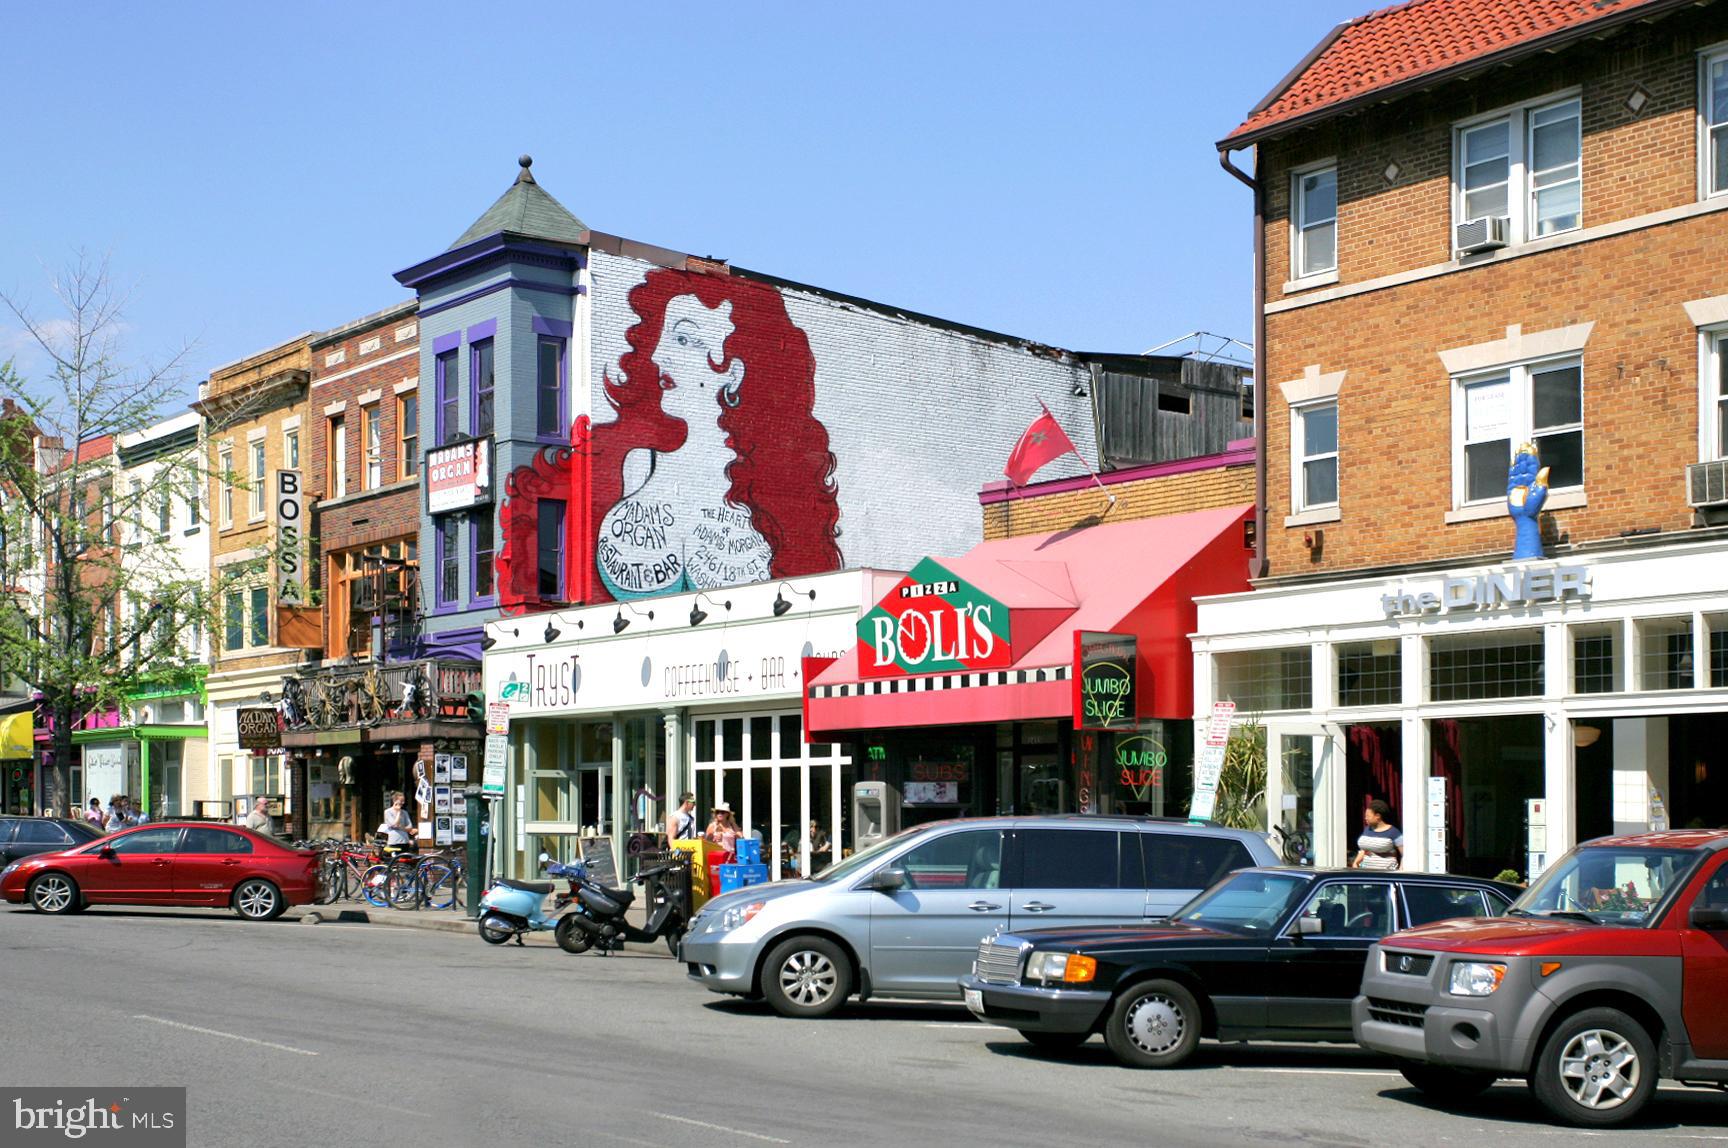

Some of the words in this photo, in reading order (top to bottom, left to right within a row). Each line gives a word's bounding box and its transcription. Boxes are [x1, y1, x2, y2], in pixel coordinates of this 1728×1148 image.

[432, 461, 472, 482] ORGAN
[700, 508, 716, 519] THE
[717, 507, 750, 529] HEART
[279, 472, 300, 600] BOSSA
[611, 519, 668, 550] ORGAN
[599, 536, 645, 589] RESTAURANT
[653, 553, 682, 584] BAR
[901, 582, 958, 598] PIZZA
[1380, 589, 1437, 615] the
[1443, 565, 1594, 609] DINER
[872, 601, 994, 667] BOLI'S
[664, 660, 740, 697] COFFEEHOUSE
[761, 656, 786, 690] BAR
[1081, 677, 1131, 696] JUMBO
[1085, 699, 1126, 718] SLICE
[238, 722, 278, 735] ORGAN
[1115, 750, 1168, 767] JUMBO
[913, 763, 966, 780] SUBS
[1120, 769, 1163, 786] SLICE
